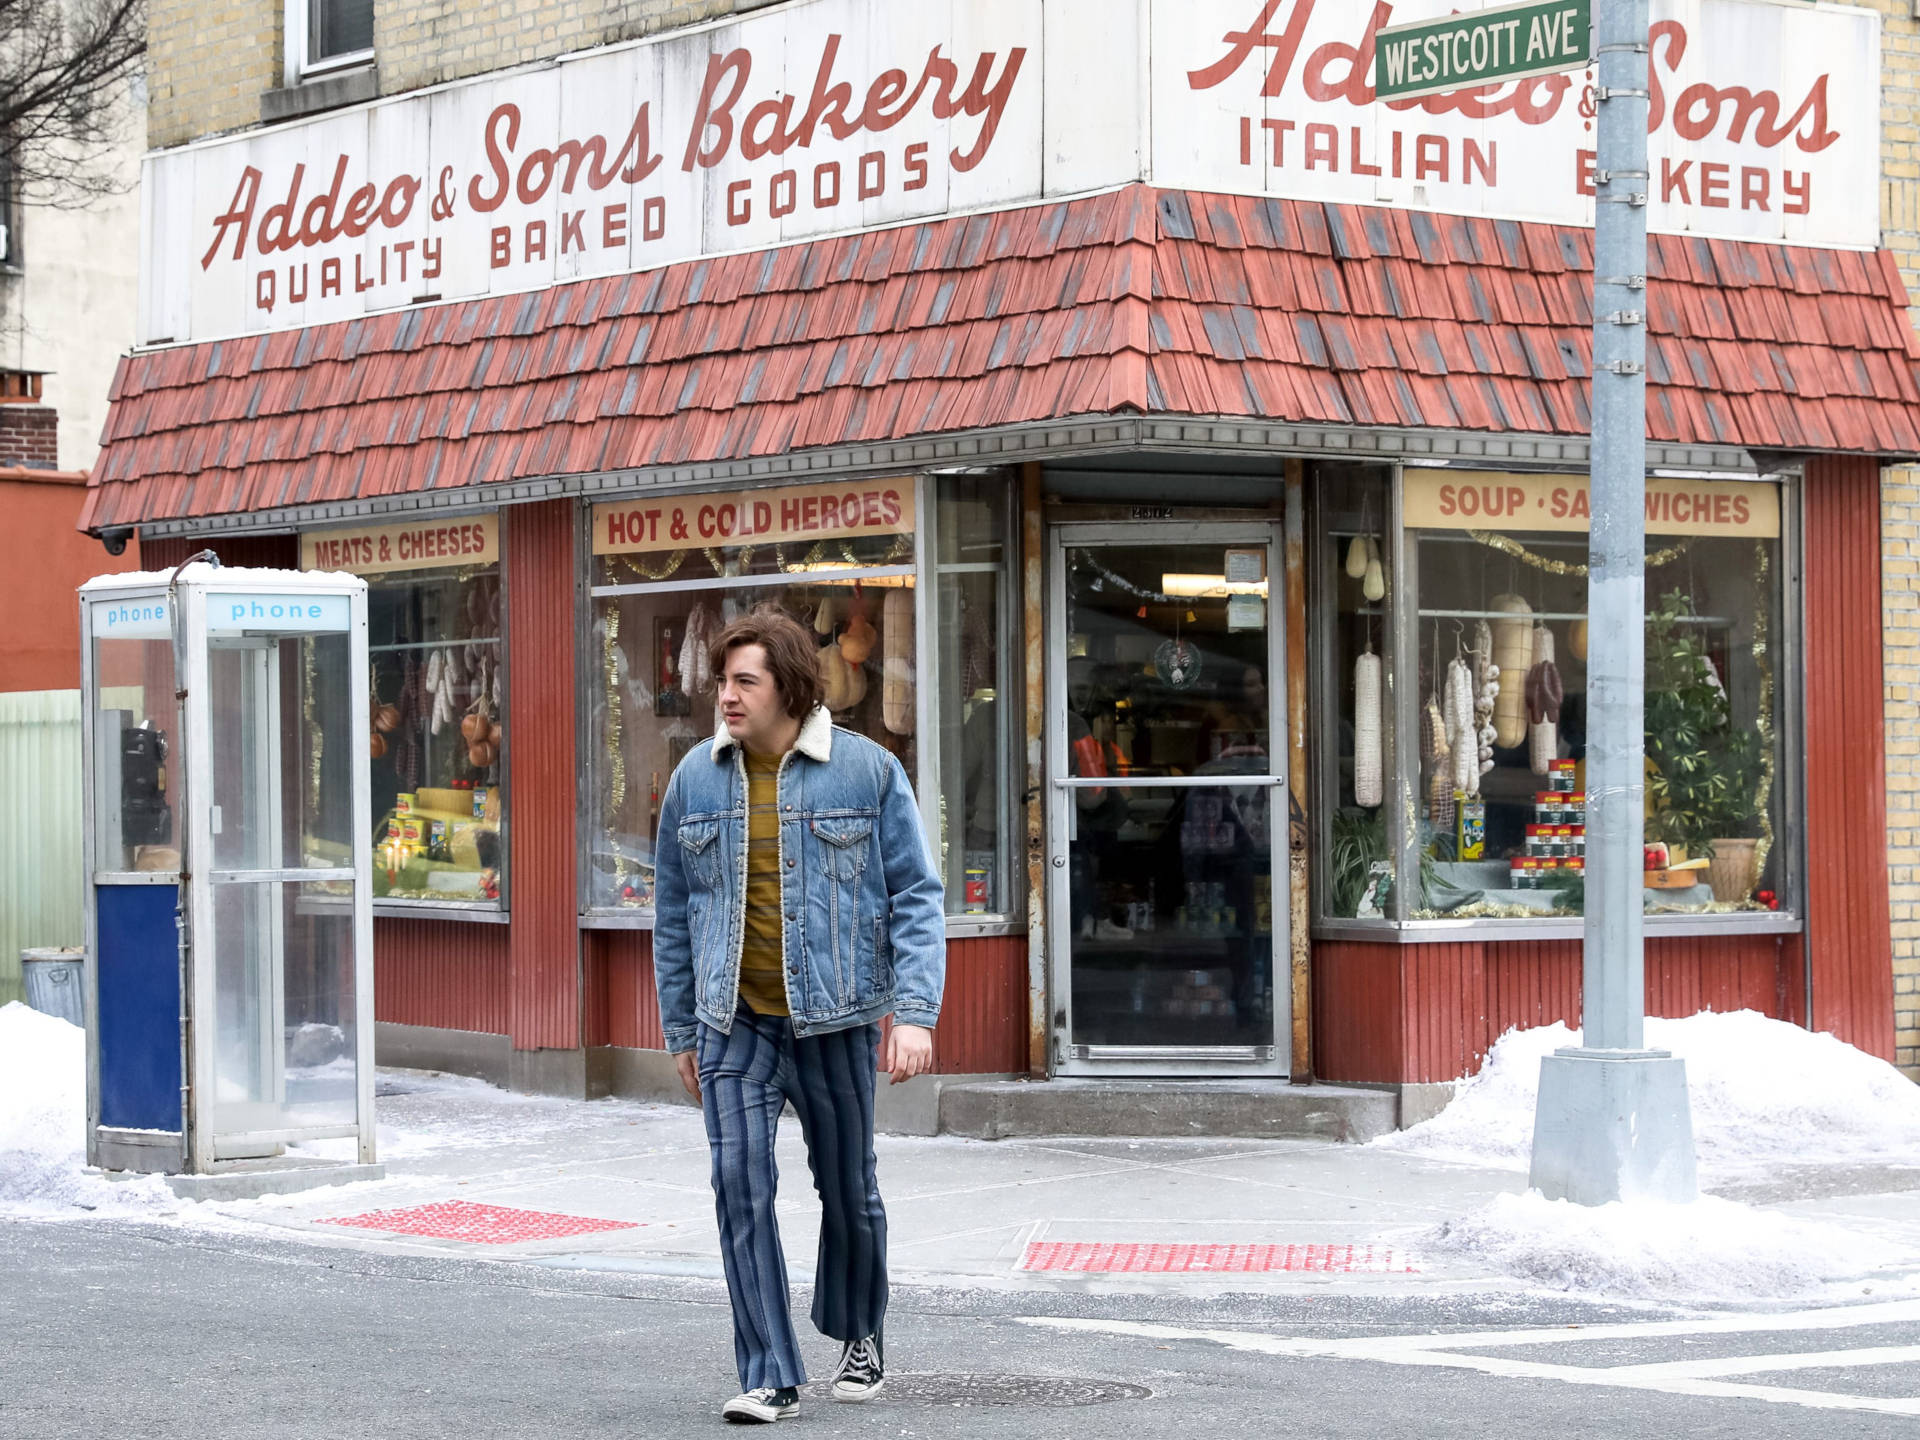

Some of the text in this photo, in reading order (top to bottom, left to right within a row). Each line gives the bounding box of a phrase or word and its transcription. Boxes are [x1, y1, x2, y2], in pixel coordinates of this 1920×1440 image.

[1186, 0, 1572, 125] Ado
[1384, 8, 1579, 87] WESTCOTT AVE
[201, 33, 1027, 271] Addeo & Sons Bakery
[1239, 116, 1810, 215] ITALIAN BKERY
[257, 142, 928, 313] QUALITY BAKED GOODS
[607, 489, 903, 545] HOT & COLD HEROES
[1439, 484, 1750, 525] SOUP SAWICHES
[315, 524, 485, 569] MEATS & CHEESES
[108, 605, 165, 627] phone
[231, 602, 322, 621] phone
